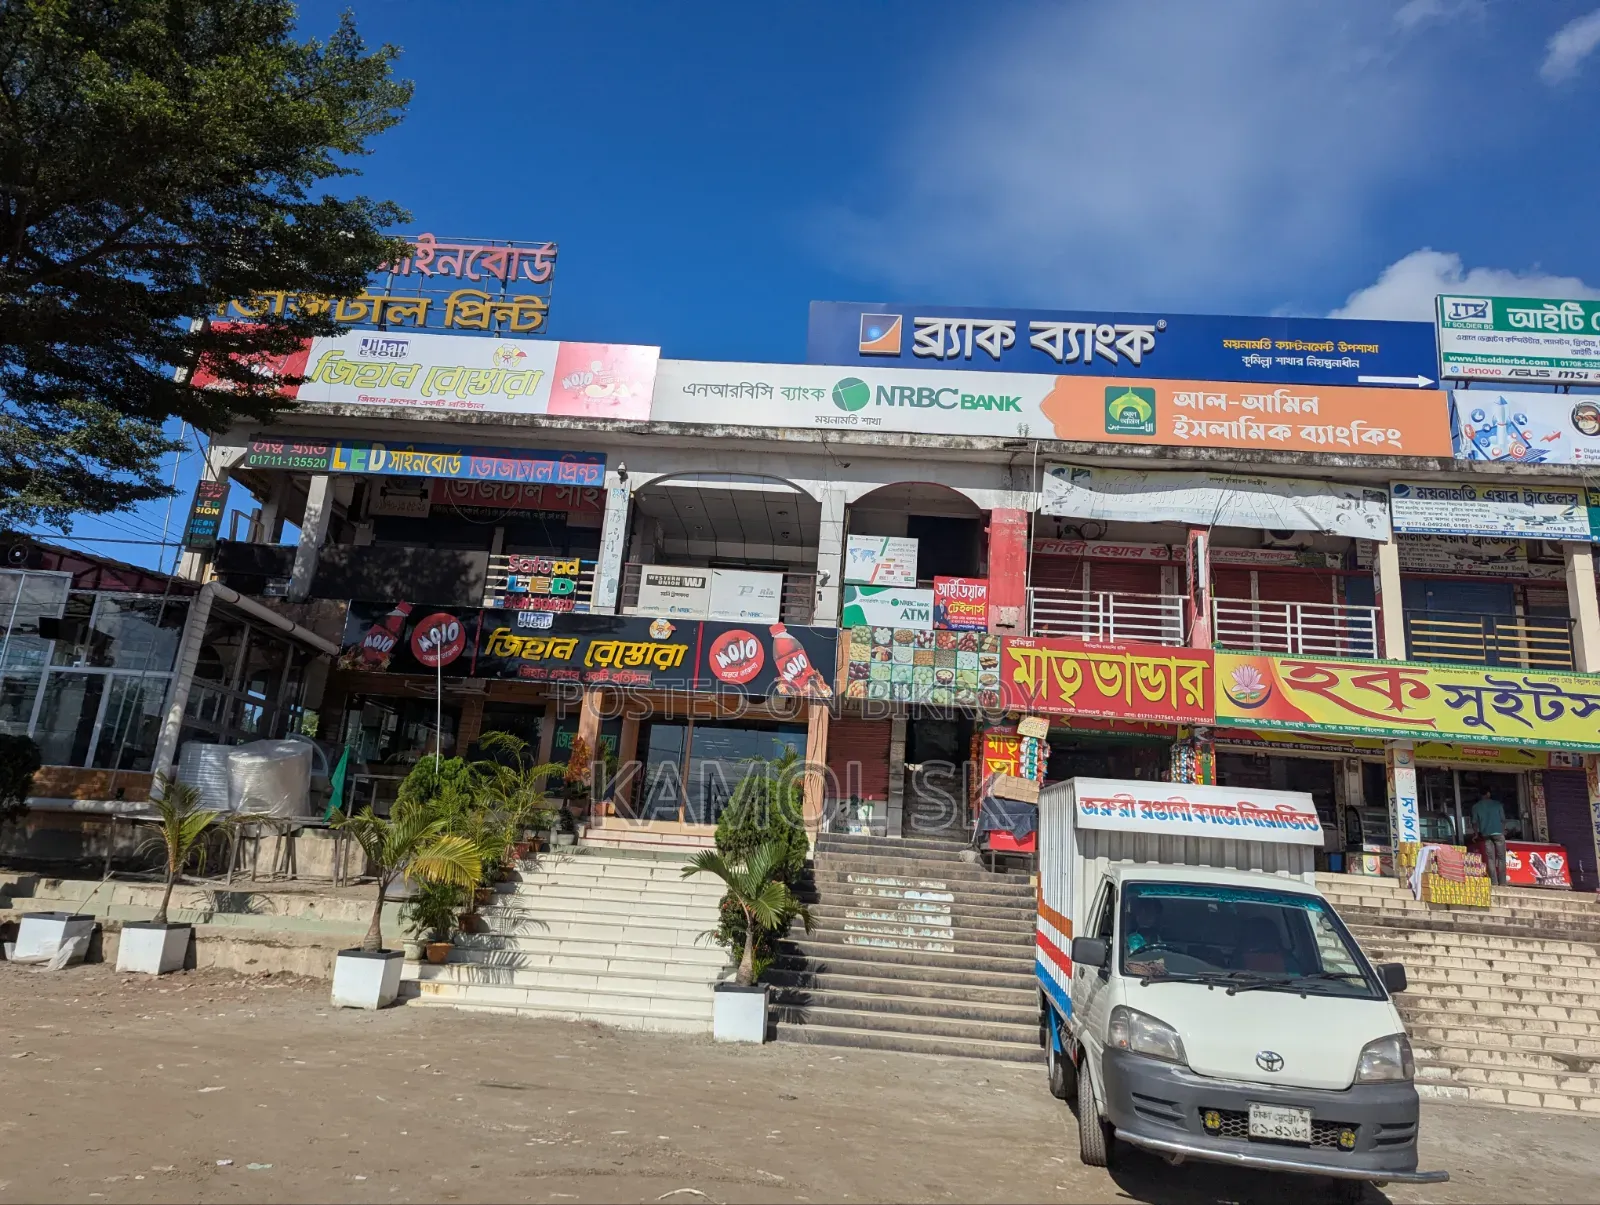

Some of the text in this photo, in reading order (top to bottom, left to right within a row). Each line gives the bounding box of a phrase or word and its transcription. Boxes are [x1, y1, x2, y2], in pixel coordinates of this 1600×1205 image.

[444, 289, 548, 332] প্রিন্ট
[1507, 302, 1586, 332] আইটি
[361, 338, 409, 352] Jihan
[913, 317, 1156, 365] ব্র্যাক ব্যাংক
[1223, 337, 1272, 352] ময়নামতি
[1337, 341, 1379, 355] উপশাখা
[359, 349, 408, 359] GROUP
[1241, 355, 1271, 370] কুমিল্লা
[1275, 356, 1303, 368] শাখার
[1449, 355, 1549, 367] www.itsoldierbd.com
[310, 350, 423, 389] জিহান
[1462, 366, 1502, 375] Lenovo
[1508, 368, 1551, 378] ASUS
[1558, 371, 1588, 379] msi
[562, 371, 594, 390] MOJO
[358, 394, 386, 404] জিহান
[682, 381, 826, 402] এনআরবিসি ব্যাংক
[875, 384, 1024, 413] NRBC BANK
[1172, 388, 1320, 417] আল-আমিন
[815, 414, 882, 427] ময়নামতি শাখা
[1172, 417, 1403, 449] ইসলামিক ব্যাংকিং
[249, 454, 327, 468] 01711-135520
[332, 441, 386, 472] LED
[388, 445, 462, 475] সাইনবোর্ড
[558, 453, 599, 483] প্রিন্ট
[1416, 484, 1477, 501] ময়নামতি
[1482, 488, 1519, 504] এয়ার
[195, 506, 220, 515] SIGN
[196, 500, 221, 508] LED
[191, 518, 216, 527] NEON
[507, 554, 580, 576] Satu ad
[506, 575, 576, 595] LED
[935, 578, 987, 602] আইডিয়াল
[503, 595, 574, 611] SIGN BOARD
[947, 601, 987, 617] টেইলার্স
[519, 612, 553, 624] Jihan
[899, 609, 930, 621] ATM
[363, 635, 395, 653] MOJO
[416, 621, 460, 653] MOJO
[484, 627, 579, 660] জিহান
[1009, 638, 1035, 648] কুমিল্লা
[714, 638, 758, 669] MOJO
[782, 653, 808, 683] MOJO
[1006, 646, 1211, 711] মাতৃ ভান্ডার
[1280, 660, 1436, 729] হক
[986, 734, 1021, 757] মাতৃ
[1080, 793, 1136, 818] জরুরী
[1138, 796, 1194, 822] রপ্তানী
[1253, 1110, 1272, 1120] ঢাকা
